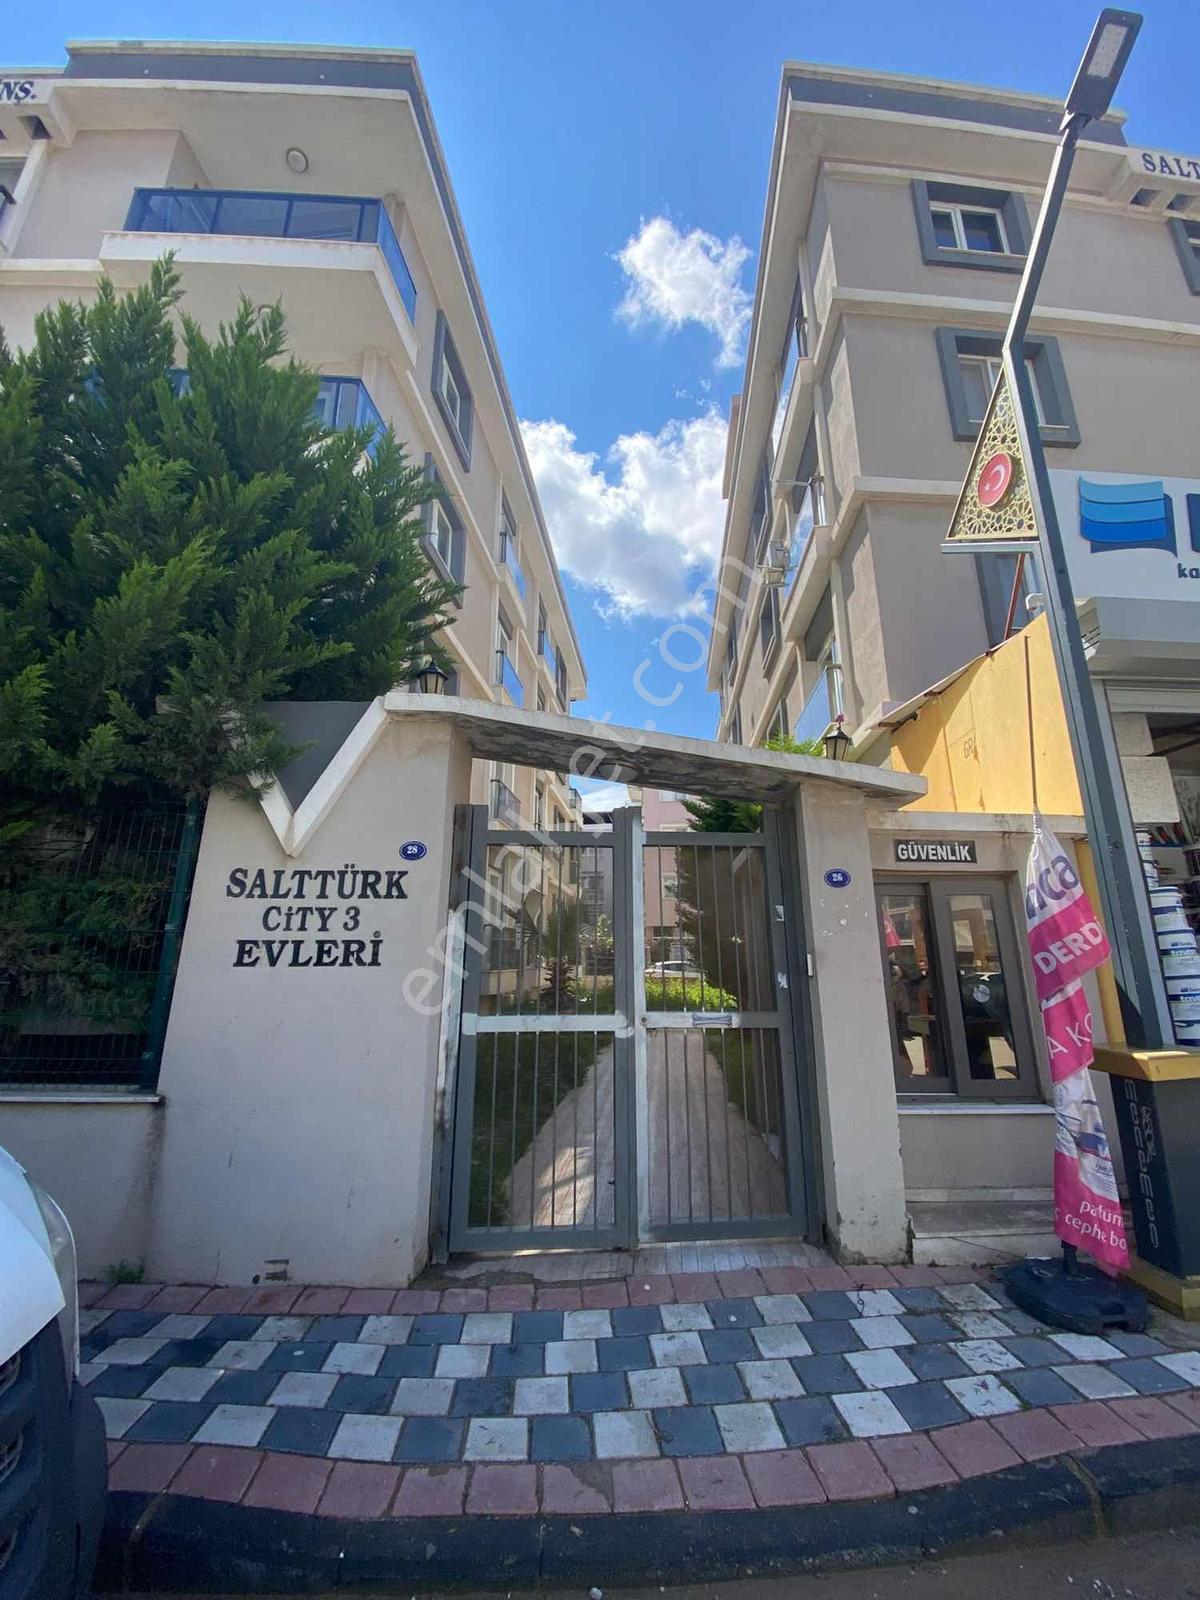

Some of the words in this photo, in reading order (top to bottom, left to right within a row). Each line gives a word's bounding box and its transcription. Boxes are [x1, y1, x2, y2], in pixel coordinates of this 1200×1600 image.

[407, 845, 418, 854] 28
[897, 841, 972, 861] GÜVENLİK
[226, 863, 409, 900] SALTTÜRK
[832, 872, 843, 881] 26
[343, 906, 361, 931] 3
[233, 931, 384, 968] EVLERİ
